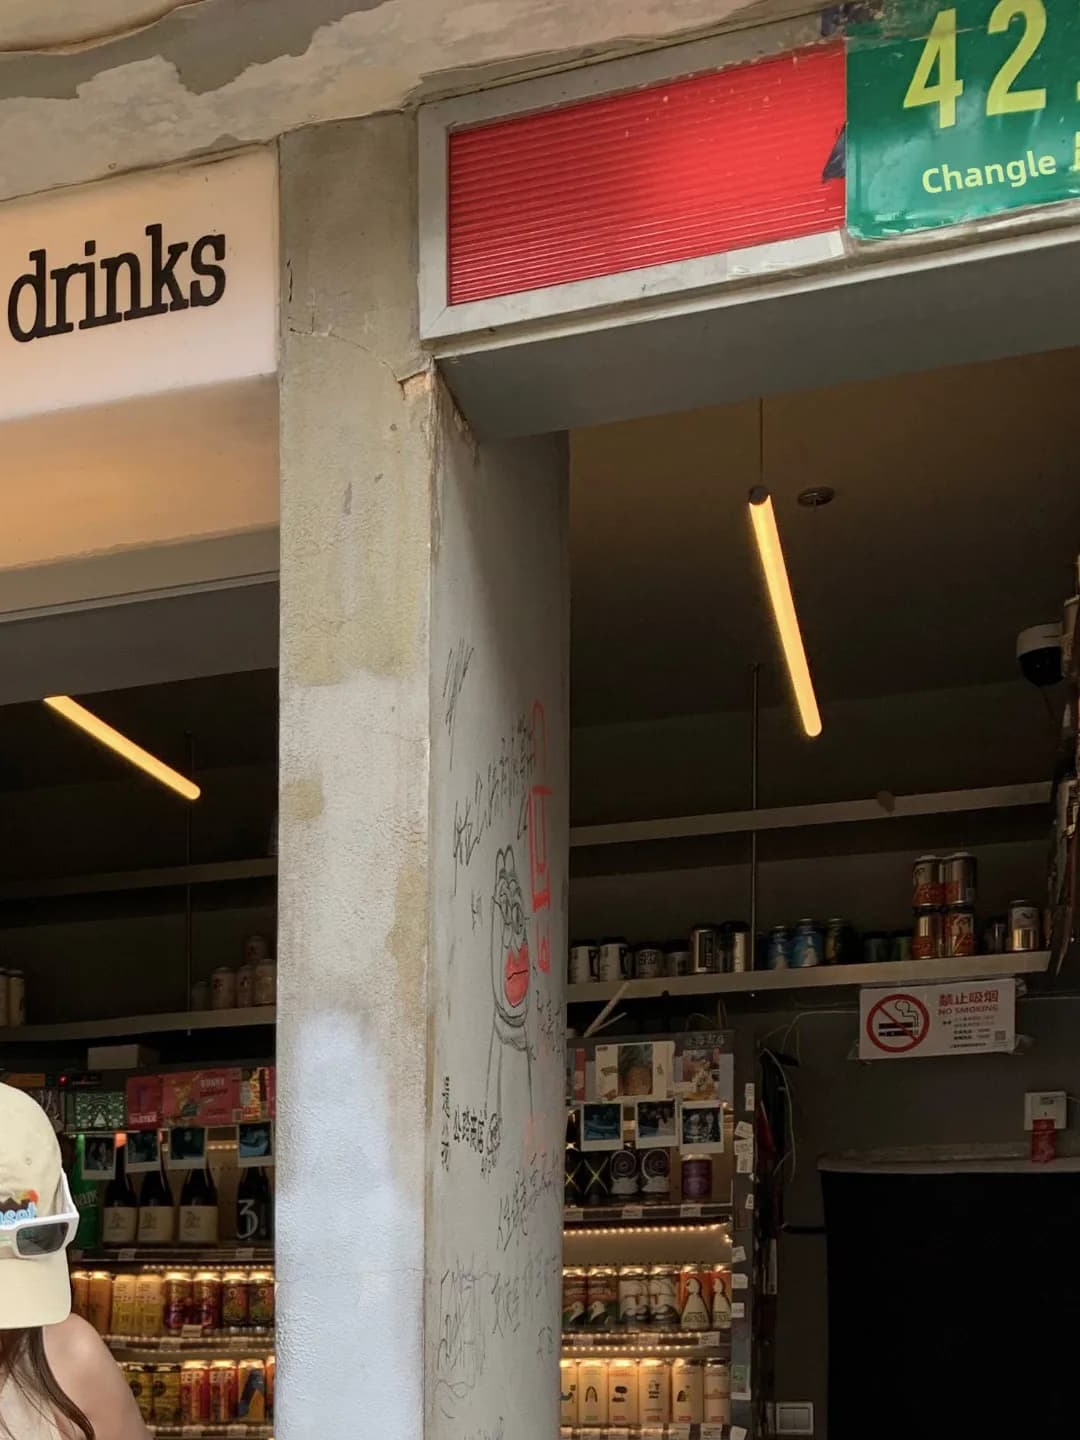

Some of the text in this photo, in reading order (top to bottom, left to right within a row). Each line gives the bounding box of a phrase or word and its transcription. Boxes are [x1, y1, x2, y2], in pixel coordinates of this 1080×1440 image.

[904, 0, 1047, 129] 42
[922, 150, 1057, 195] Changle
[7, 223, 226, 343] drinks
[938, 1005, 999, 1016] NO SMOKING
